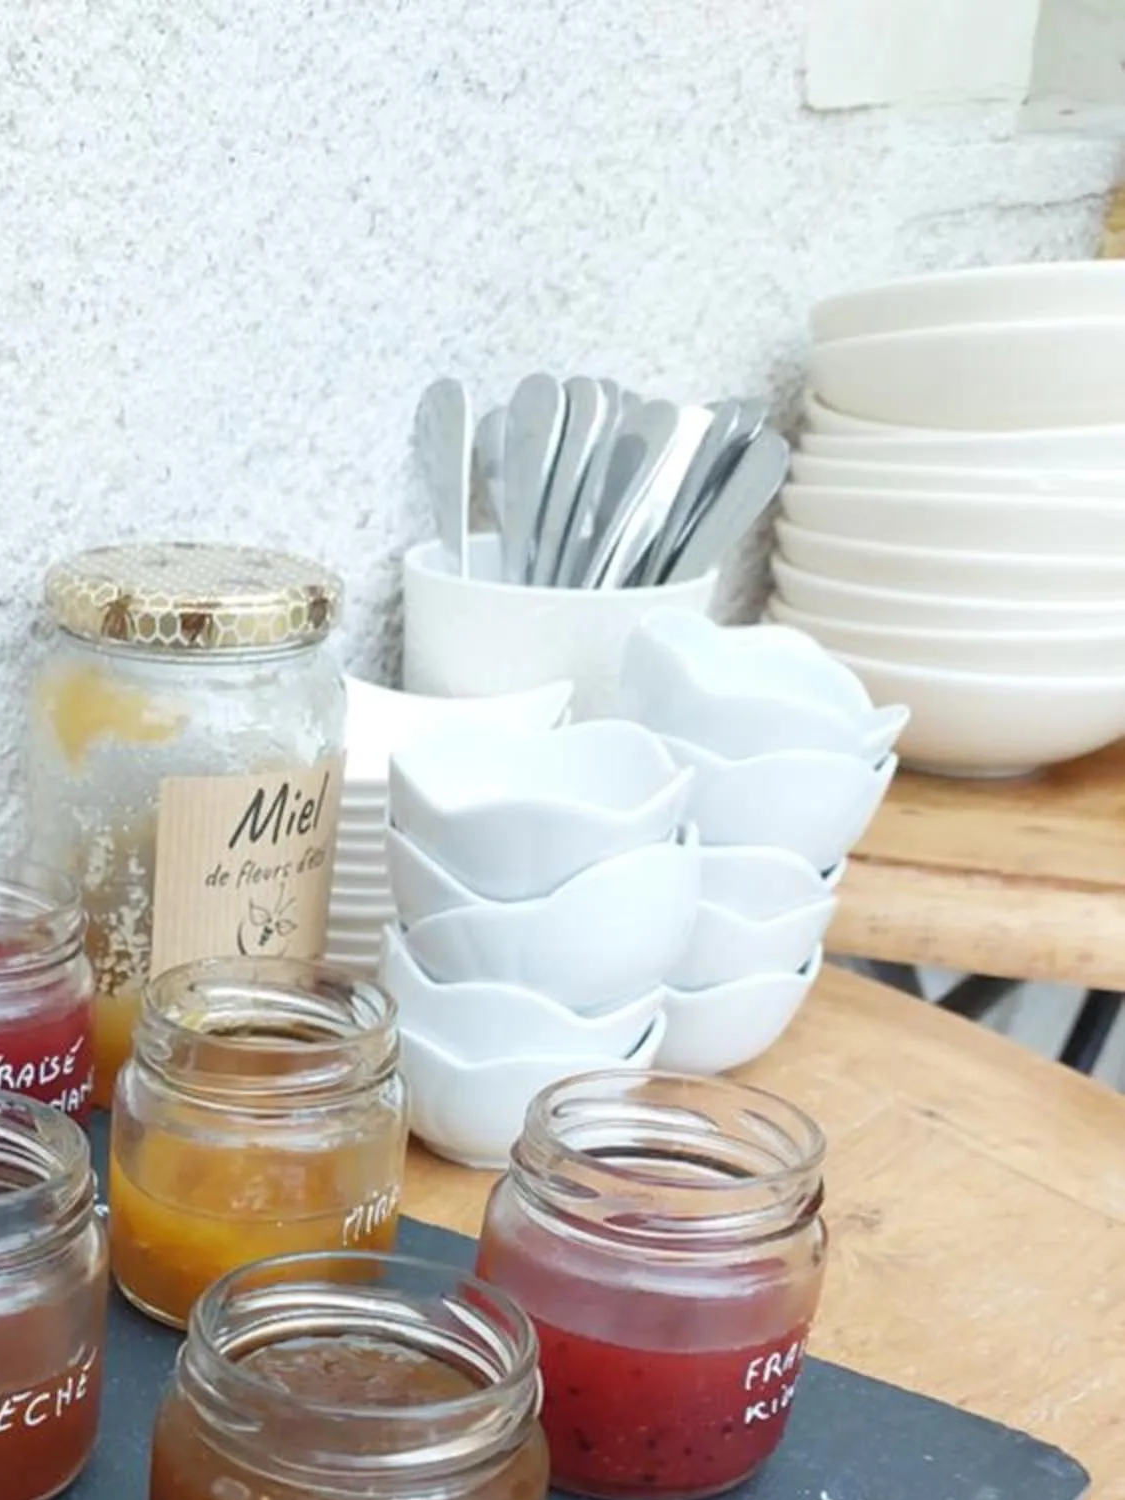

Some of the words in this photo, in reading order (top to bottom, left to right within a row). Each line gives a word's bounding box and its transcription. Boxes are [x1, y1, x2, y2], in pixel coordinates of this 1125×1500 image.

[228, 771, 330, 849] Miel
[205, 863, 230, 887] de
[235, 859, 292, 889] fleurs
